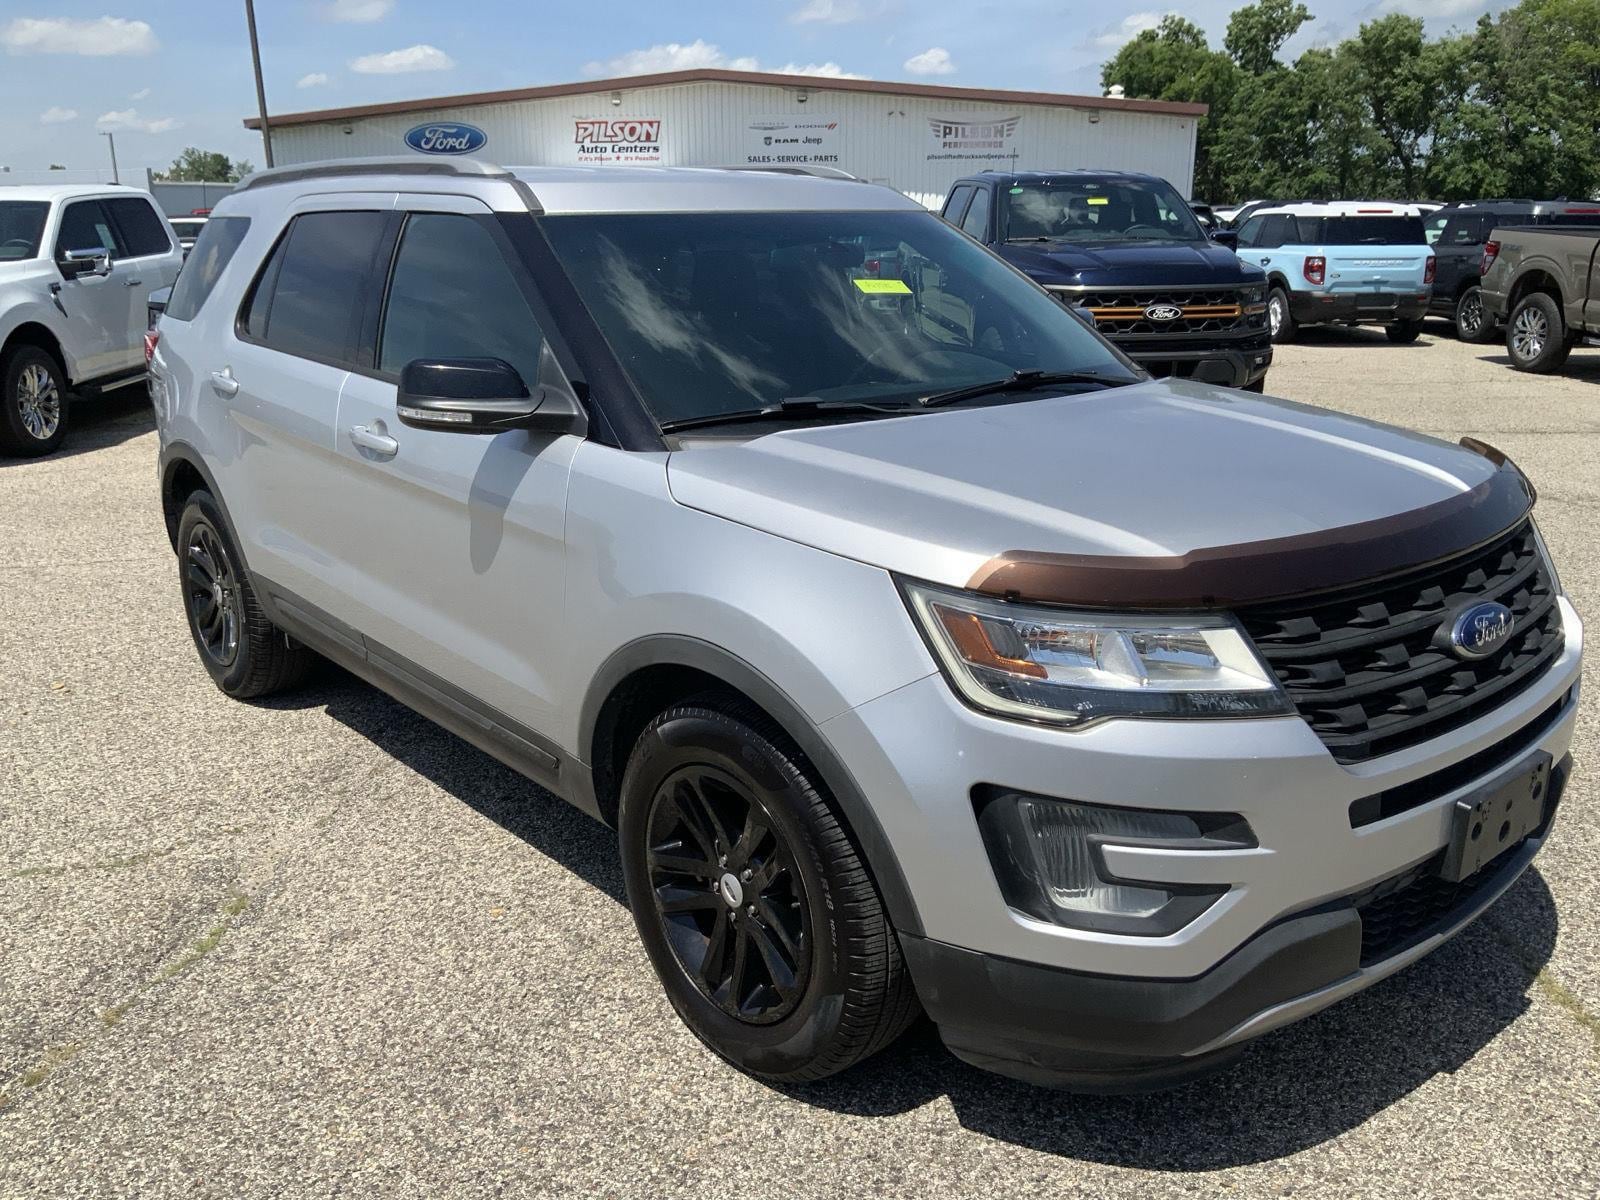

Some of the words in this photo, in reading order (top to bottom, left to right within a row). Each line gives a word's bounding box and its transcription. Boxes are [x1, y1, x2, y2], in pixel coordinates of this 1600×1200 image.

[575, 121, 661, 143] PILSON
[943, 124, 1004, 139] PILSON
[421, 127, 470, 149] Ford
[802, 136, 823, 145] Jeep
[577, 145, 608, 154] Auto
[611, 145, 660, 154] Centers
[942, 141, 1004, 149] PERFORMANCE
[747, 155, 771, 163] SALES
[776, 155, 808, 163] SERVICE
[813, 154, 839, 162] PARTS
[1152, 308, 1175, 318] Ford
[1475, 610, 1507, 647] Ford
